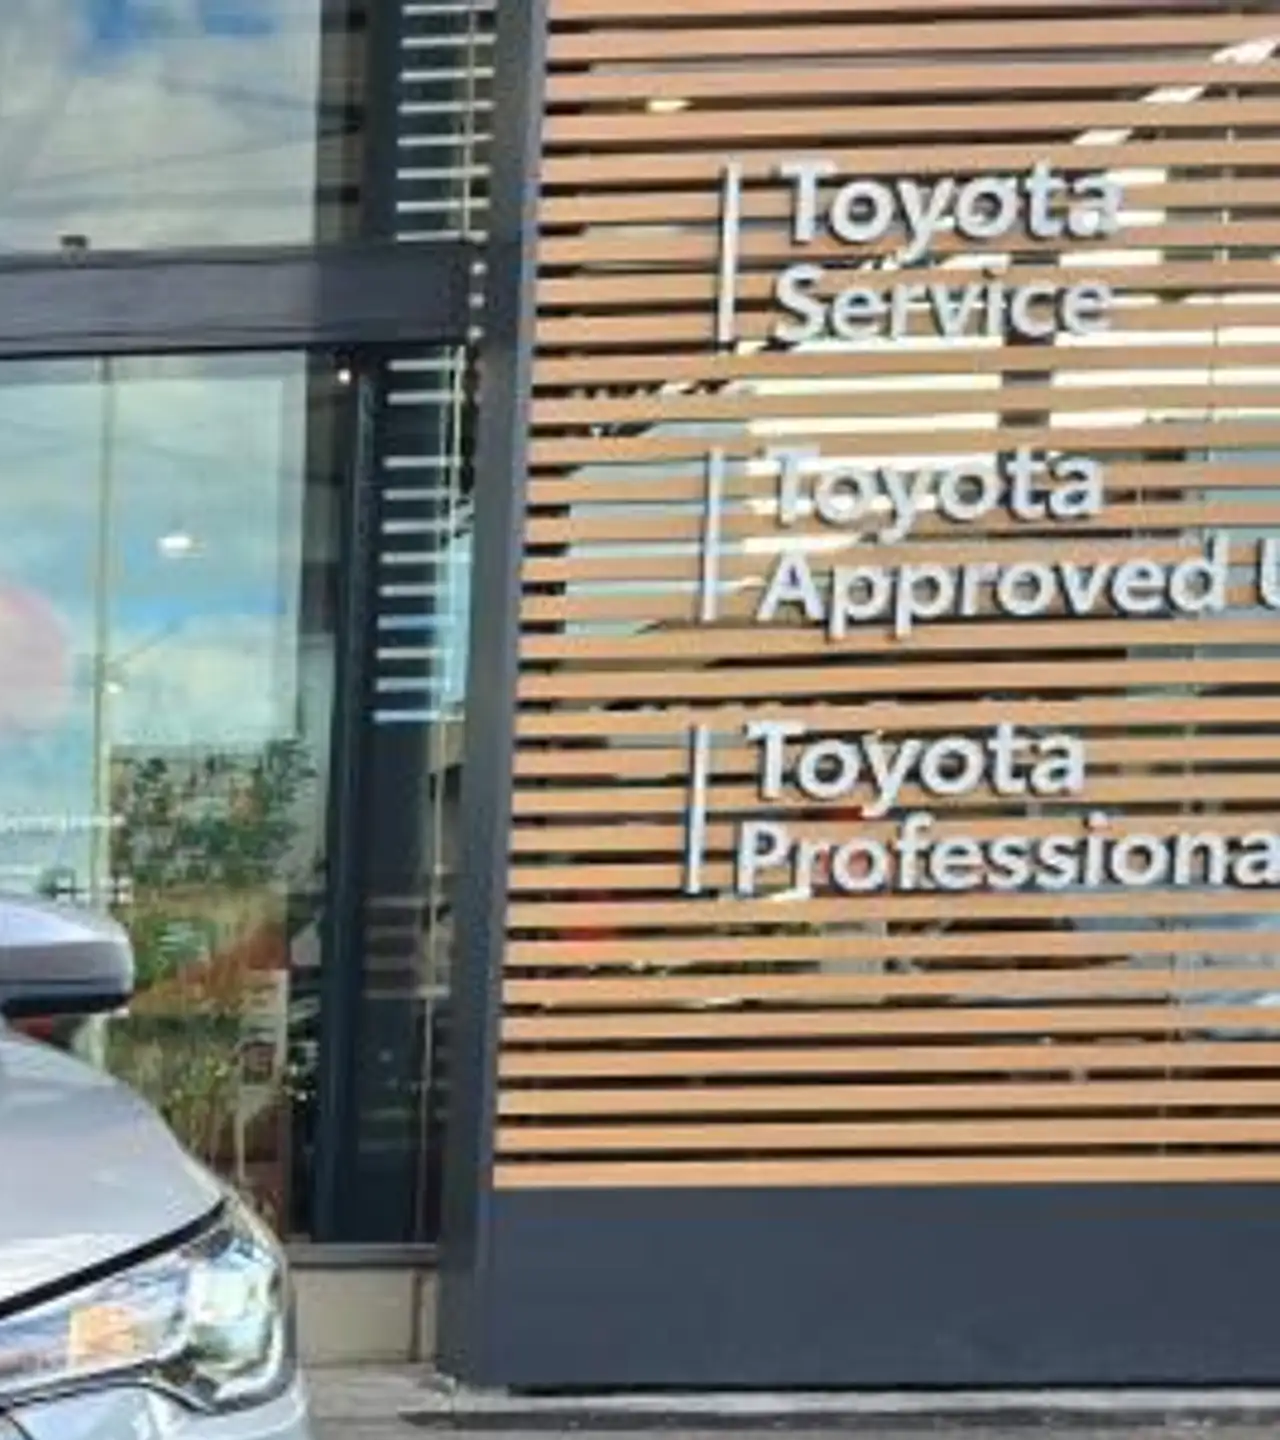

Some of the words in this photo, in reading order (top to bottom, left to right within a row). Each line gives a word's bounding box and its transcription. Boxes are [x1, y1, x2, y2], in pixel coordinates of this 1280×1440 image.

[778, 155, 1124, 262] Toyota
[773, 264, 1114, 343] Service
[760, 446, 1105, 540] Toyota
[755, 533, 1228, 639] Approved
[746, 718, 1086, 818] Toyota
[739, 811, 1280, 894] Professiona
